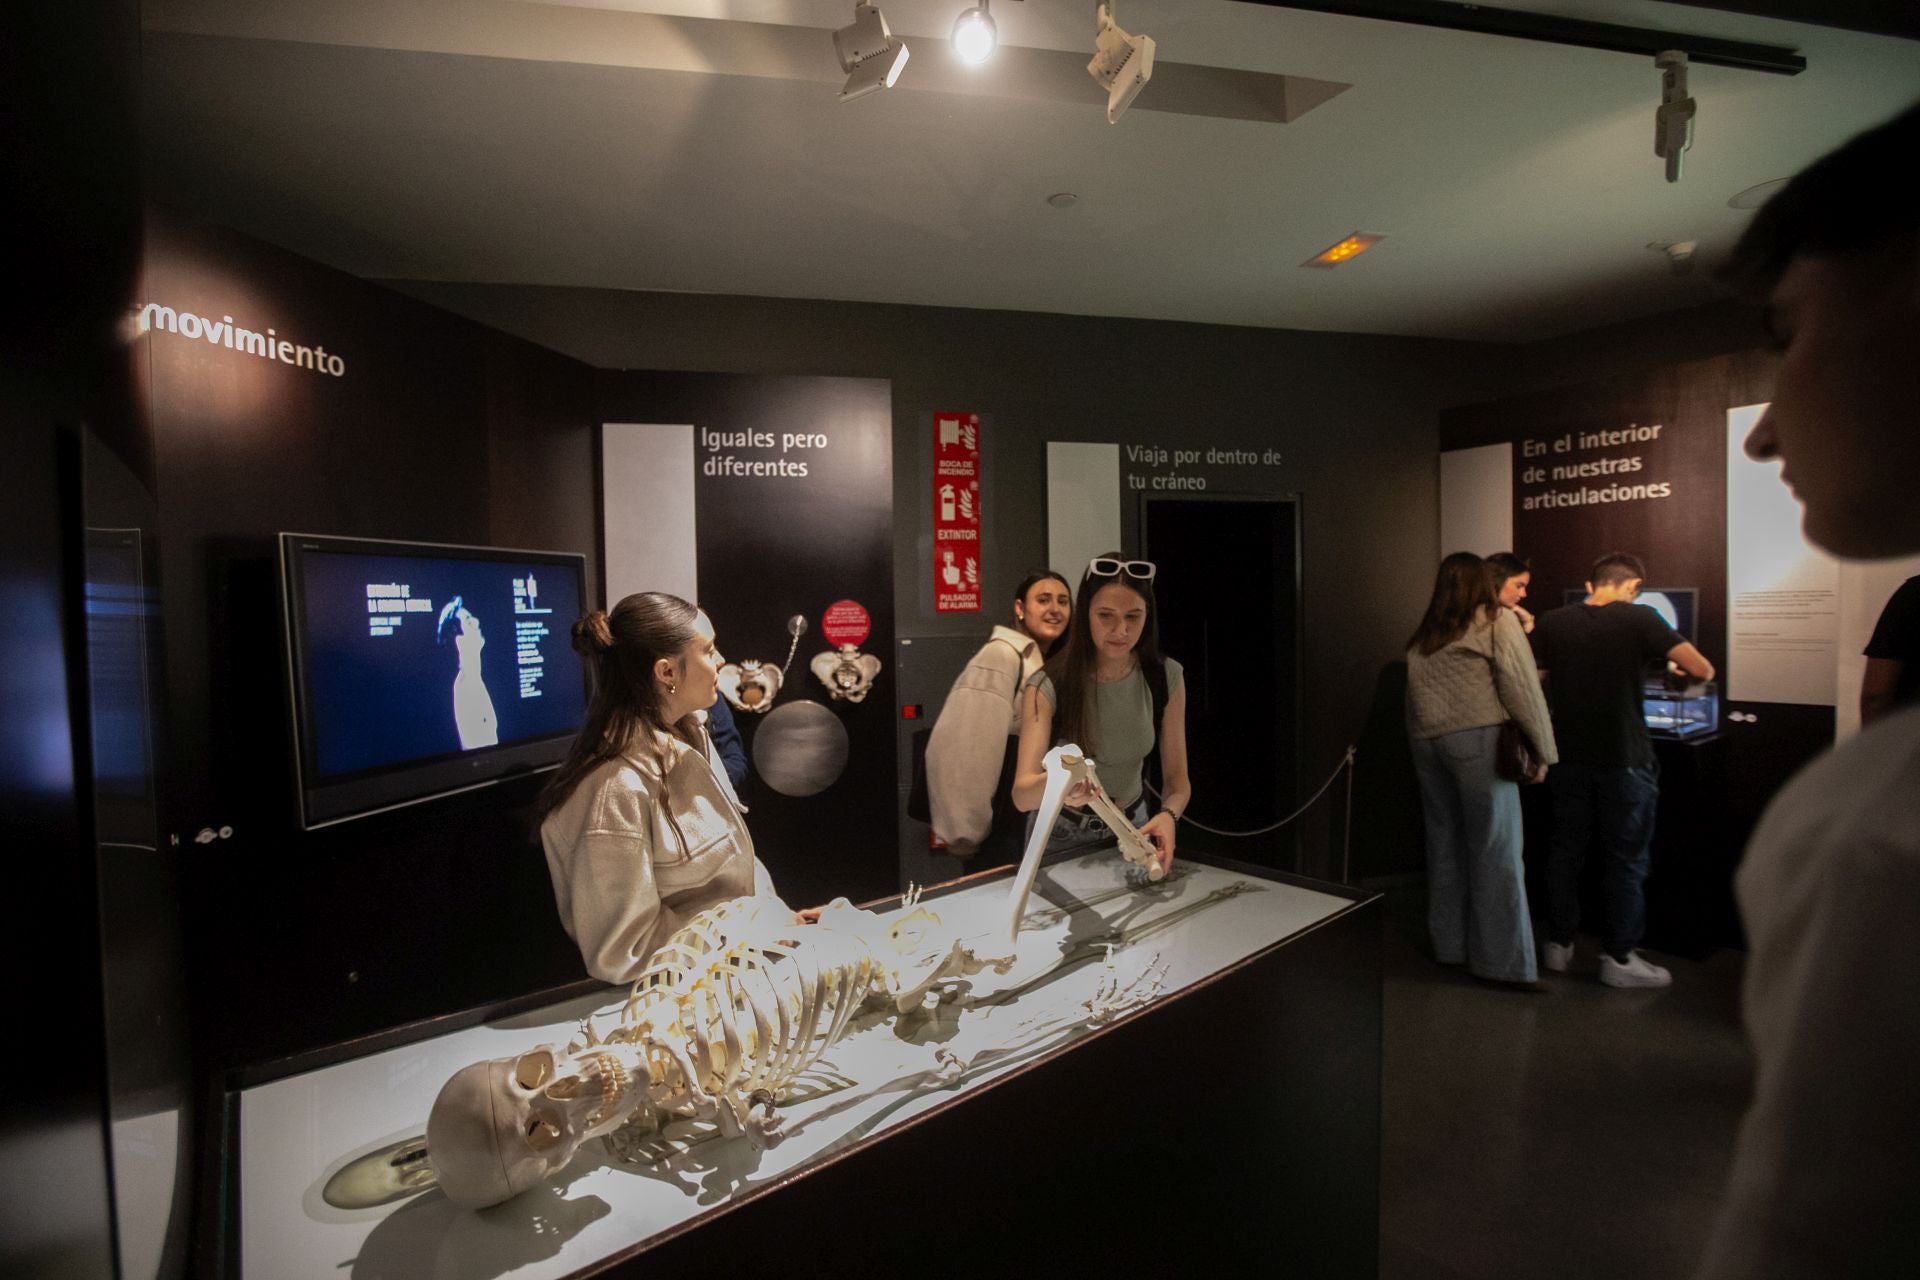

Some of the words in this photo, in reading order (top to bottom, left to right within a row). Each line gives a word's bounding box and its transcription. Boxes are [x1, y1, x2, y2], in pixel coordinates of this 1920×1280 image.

[140, 303, 345, 377] movimiento
[702, 427, 775, 452] Iguales
[782, 433, 828, 453] pero
[1523, 439, 1547, 457] En
[1554, 434, 1571, 453] el
[1580, 424, 1662, 450] interior
[939, 460, 962, 468] BOCA
[963, 461, 973, 469] DE
[1126, 444, 1168, 467] Viaja
[1174, 450, 1200, 467] por
[1206, 448, 1258, 465] dentro
[1263, 449, 1281, 465] de
[703, 456, 808, 477] diferentes
[938, 468, 975, 476] INCENDIO
[1523, 467, 1546, 483] de
[1553, 456, 1642, 480] nuestras
[1128, 473, 1146, 489] tu
[1152, 472, 1206, 490] cráneo
[1523, 482, 1672, 510] articulaciones
[938, 529, 977, 540] EXTINTOR
[939, 593, 977, 601] PULSADOR
[939, 601, 949, 609] DE
[950, 601, 978, 609] ALARMA
